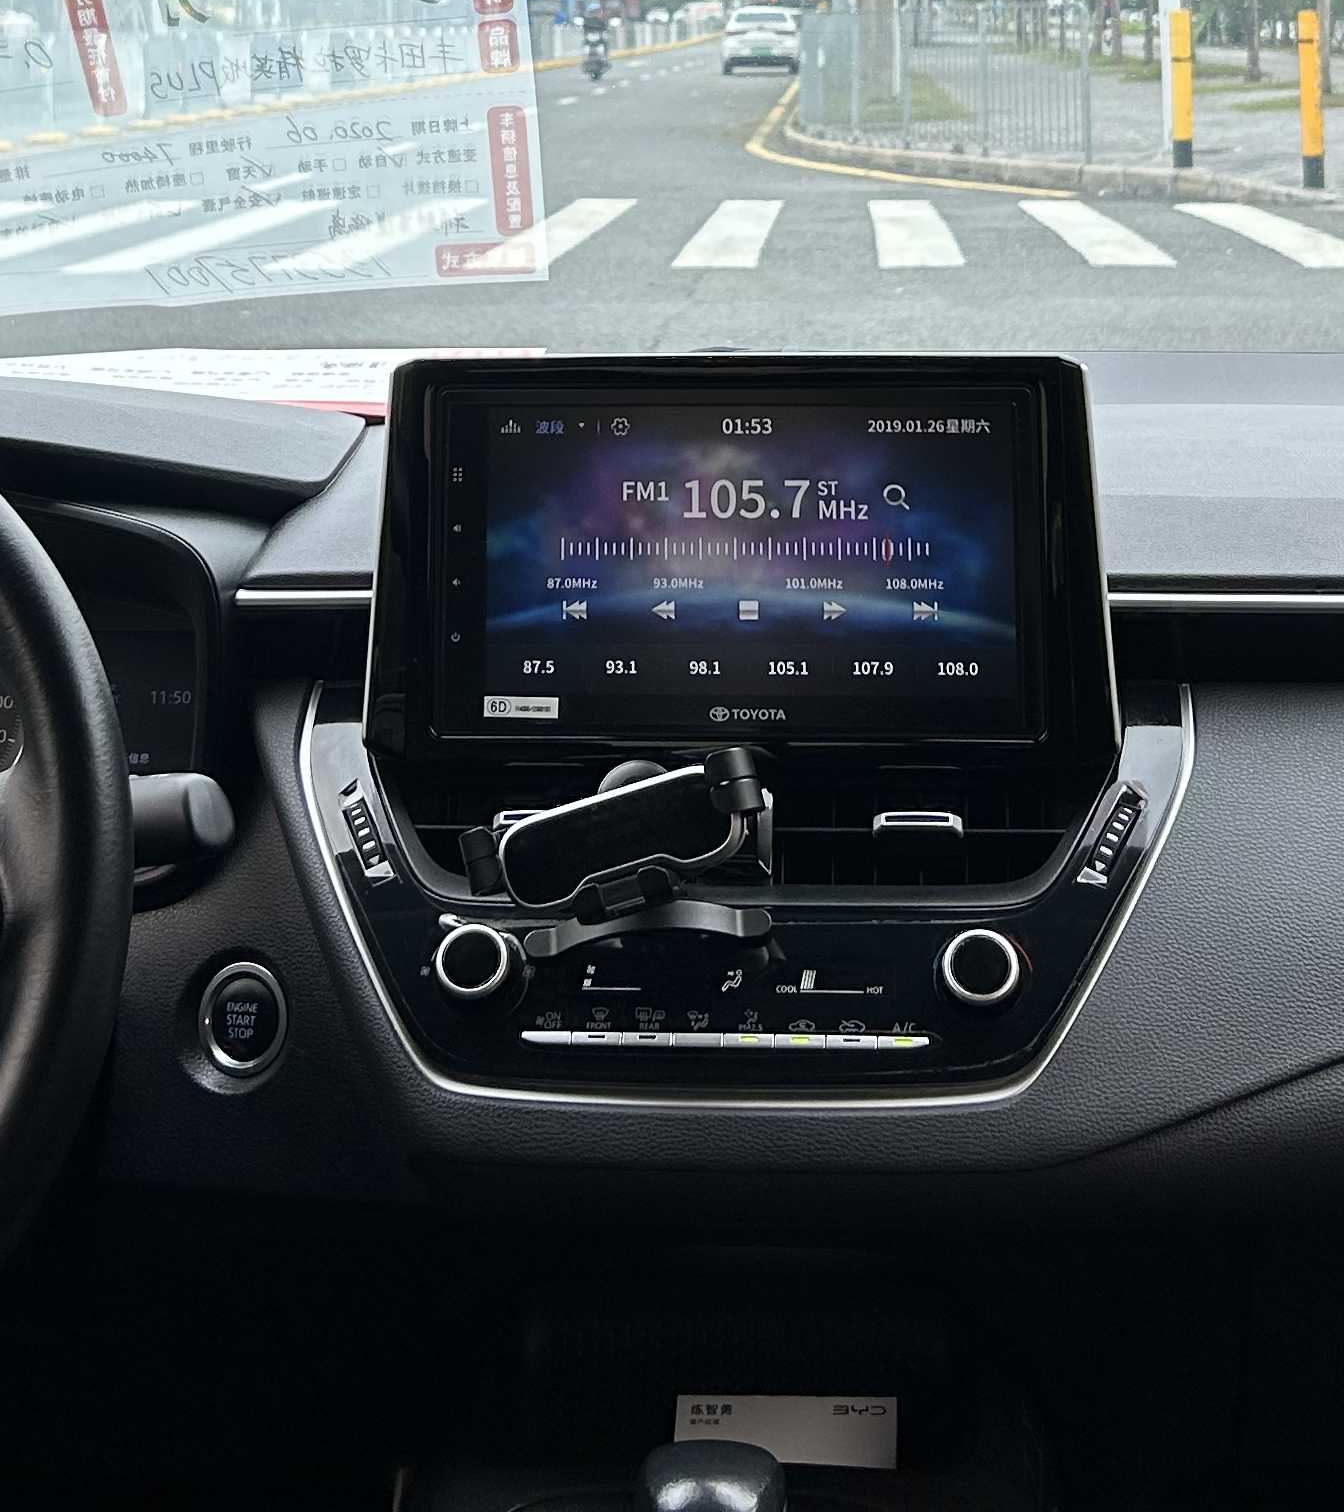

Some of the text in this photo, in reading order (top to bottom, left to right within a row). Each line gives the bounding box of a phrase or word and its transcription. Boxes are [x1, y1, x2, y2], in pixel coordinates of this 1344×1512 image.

[723, 419, 772, 434] 01:53
[868, 419, 990, 433] 2019.01.26星期六
[818, 481, 838, 495] ST
[623, 480, 809, 518] FM1 105.7
[819, 500, 868, 520] MHz
[547, 578, 597, 588] 87.0MHz
[654, 578, 703, 588] 93.0MHz
[786, 578, 843, 589] 101.0MHz
[886, 578, 943, 589] 108.0MHz
[524, 661, 554, 673] 87.5
[606, 661, 637, 673] 93.1
[690, 661, 720, 674] 98.1
[769, 662, 808, 675] 105.1
[853, 662, 893, 675] 107.9
[938, 662, 978, 675] 108.0
[151, 691, 191, 704] 11:50
[732, 709, 785, 720] TOYOTA
[776, 985, 797, 993] COOL
[867, 986, 883, 994] HOT
[227, 1002, 257, 1014] ENGINE
[227, 1015, 256, 1026] START
[543, 1012, 560, 1021] ON
[544, 1020, 561, 1029] OFF
[892, 1022, 916, 1033] A/C
[229, 1027, 253, 1038] STOP
